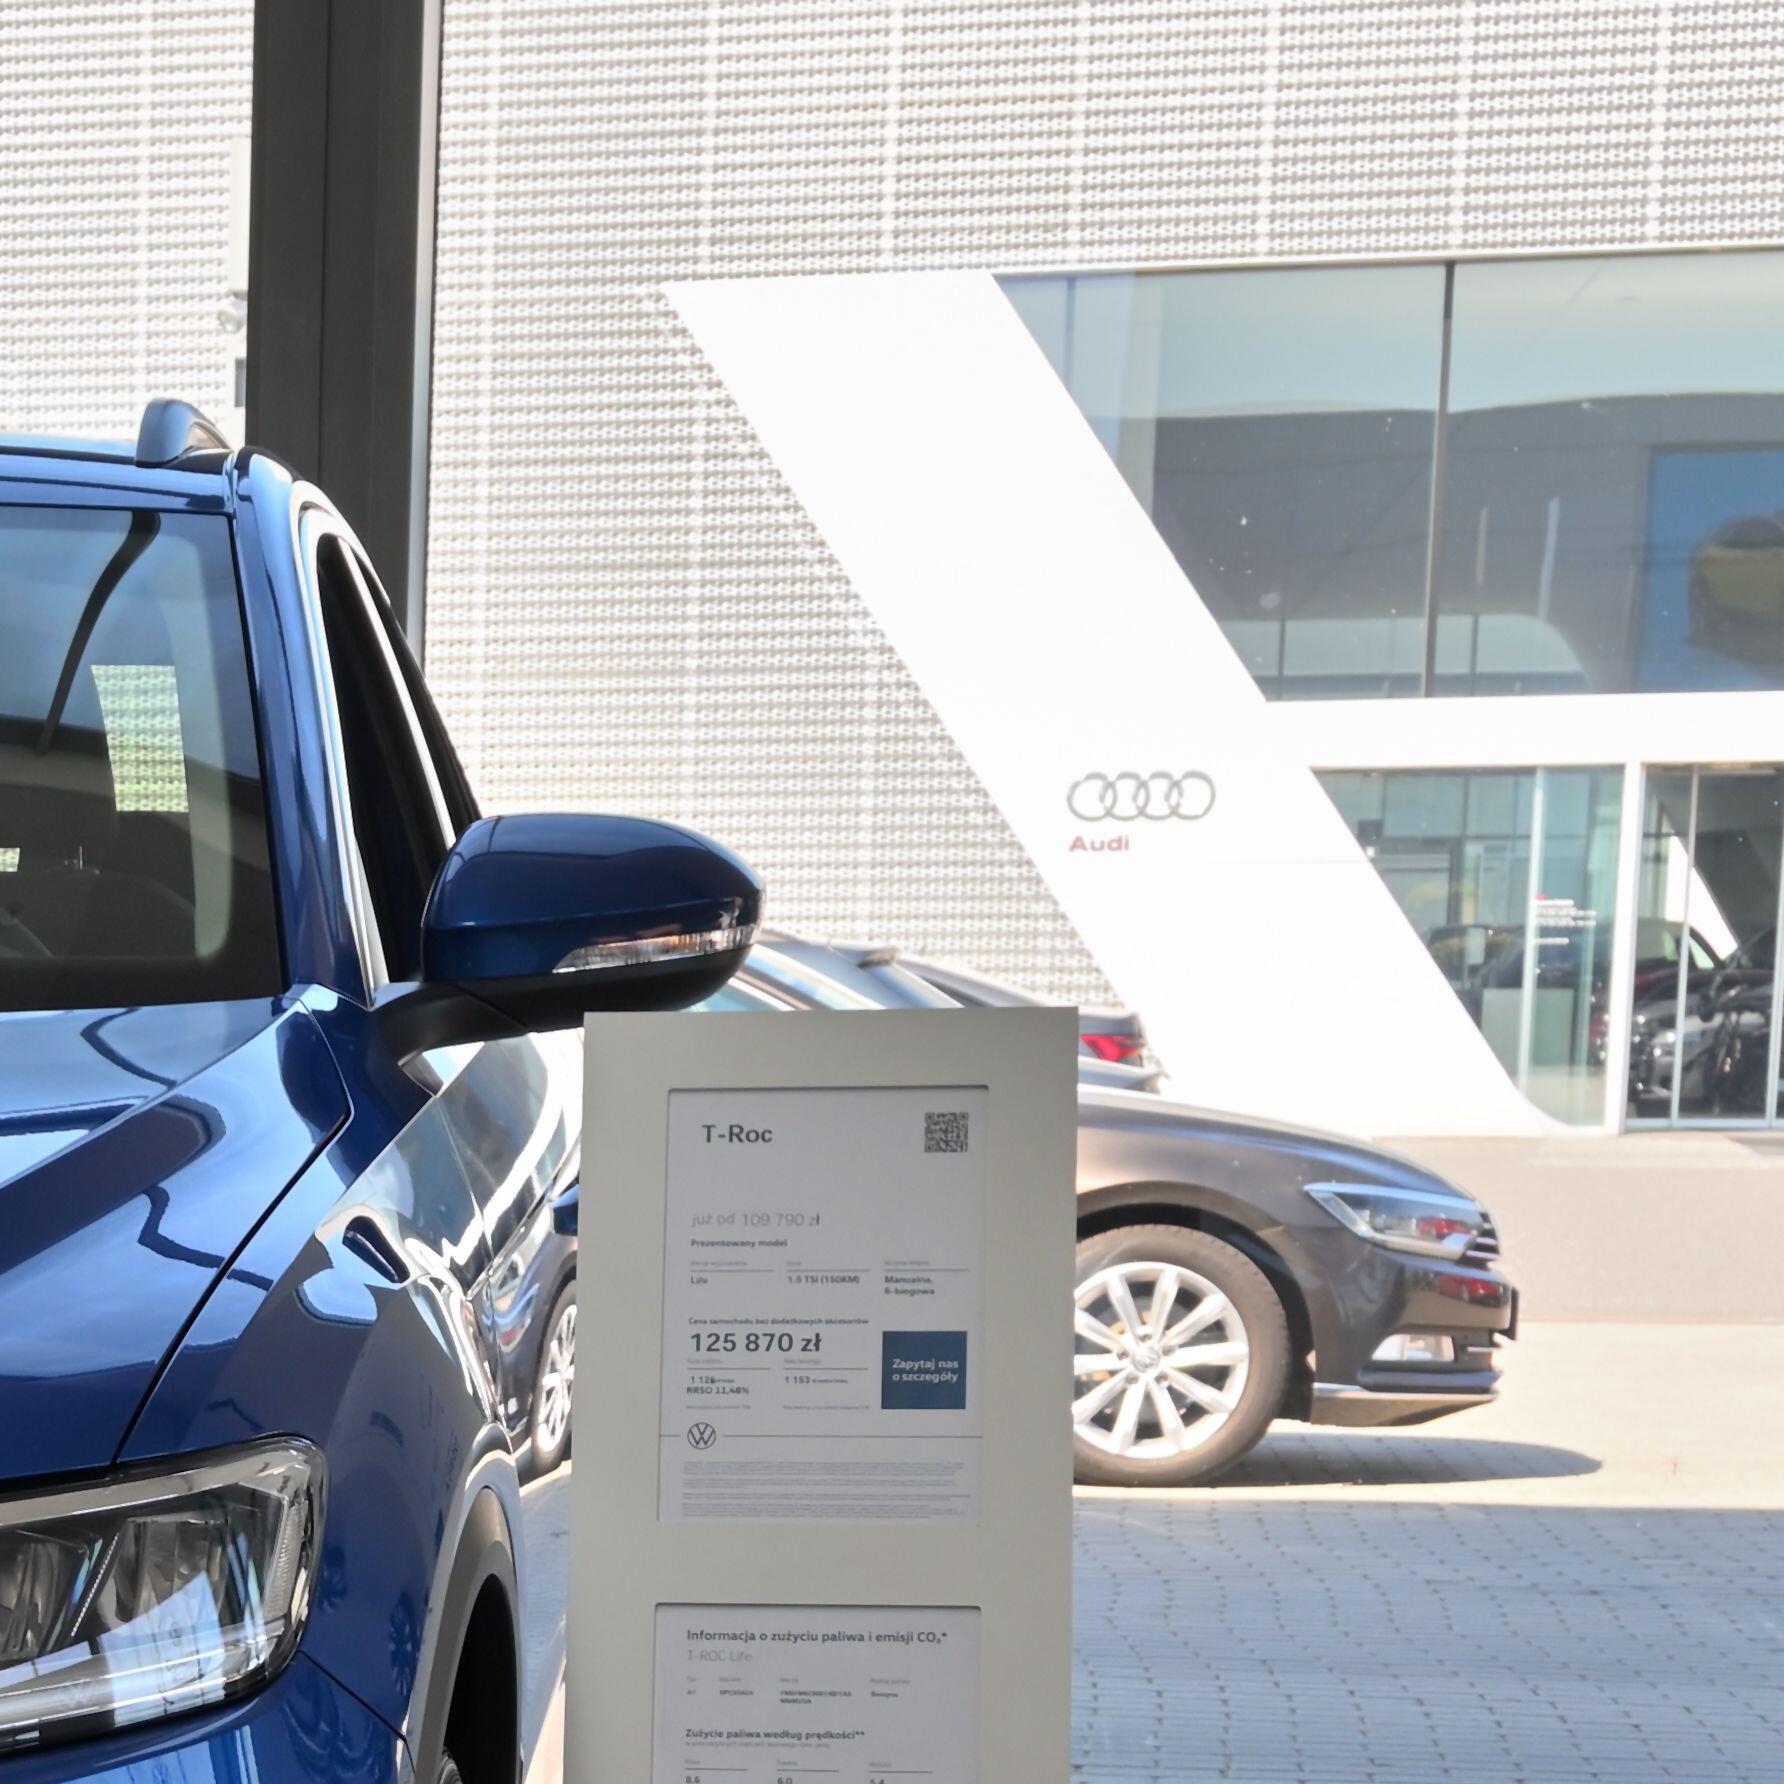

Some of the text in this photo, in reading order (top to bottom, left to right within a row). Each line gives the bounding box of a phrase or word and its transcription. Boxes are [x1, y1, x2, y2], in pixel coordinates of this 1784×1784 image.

[1068, 834, 1130, 852] Audi
[702, 1124, 773, 1144] T-Roc
[716, 1213, 735, 1226] od
[743, 1213, 771, 1227] 109
[776, 1213, 805, 1227] 790
[690, 1238, 788, 1249] Prezentowany model
[690, 1332, 822, 1353] 125 870 zł
[892, 1358, 959, 1371] Zapytaj nas
[901, 1371, 959, 1383] szczegóły
[686, 1629, 756, 1643] Informacja
[759, 1633, 768, 1642] o
[770, 1630, 819, 1644] zużyciu
[821, 1631, 865, 1645] paliwa
[875, 1631, 914, 1645] emisji
[685, 1728, 724, 1740] Zużycie
[726, 1729, 761, 1741] paliwa
[763, 1730, 802, 1742] według
